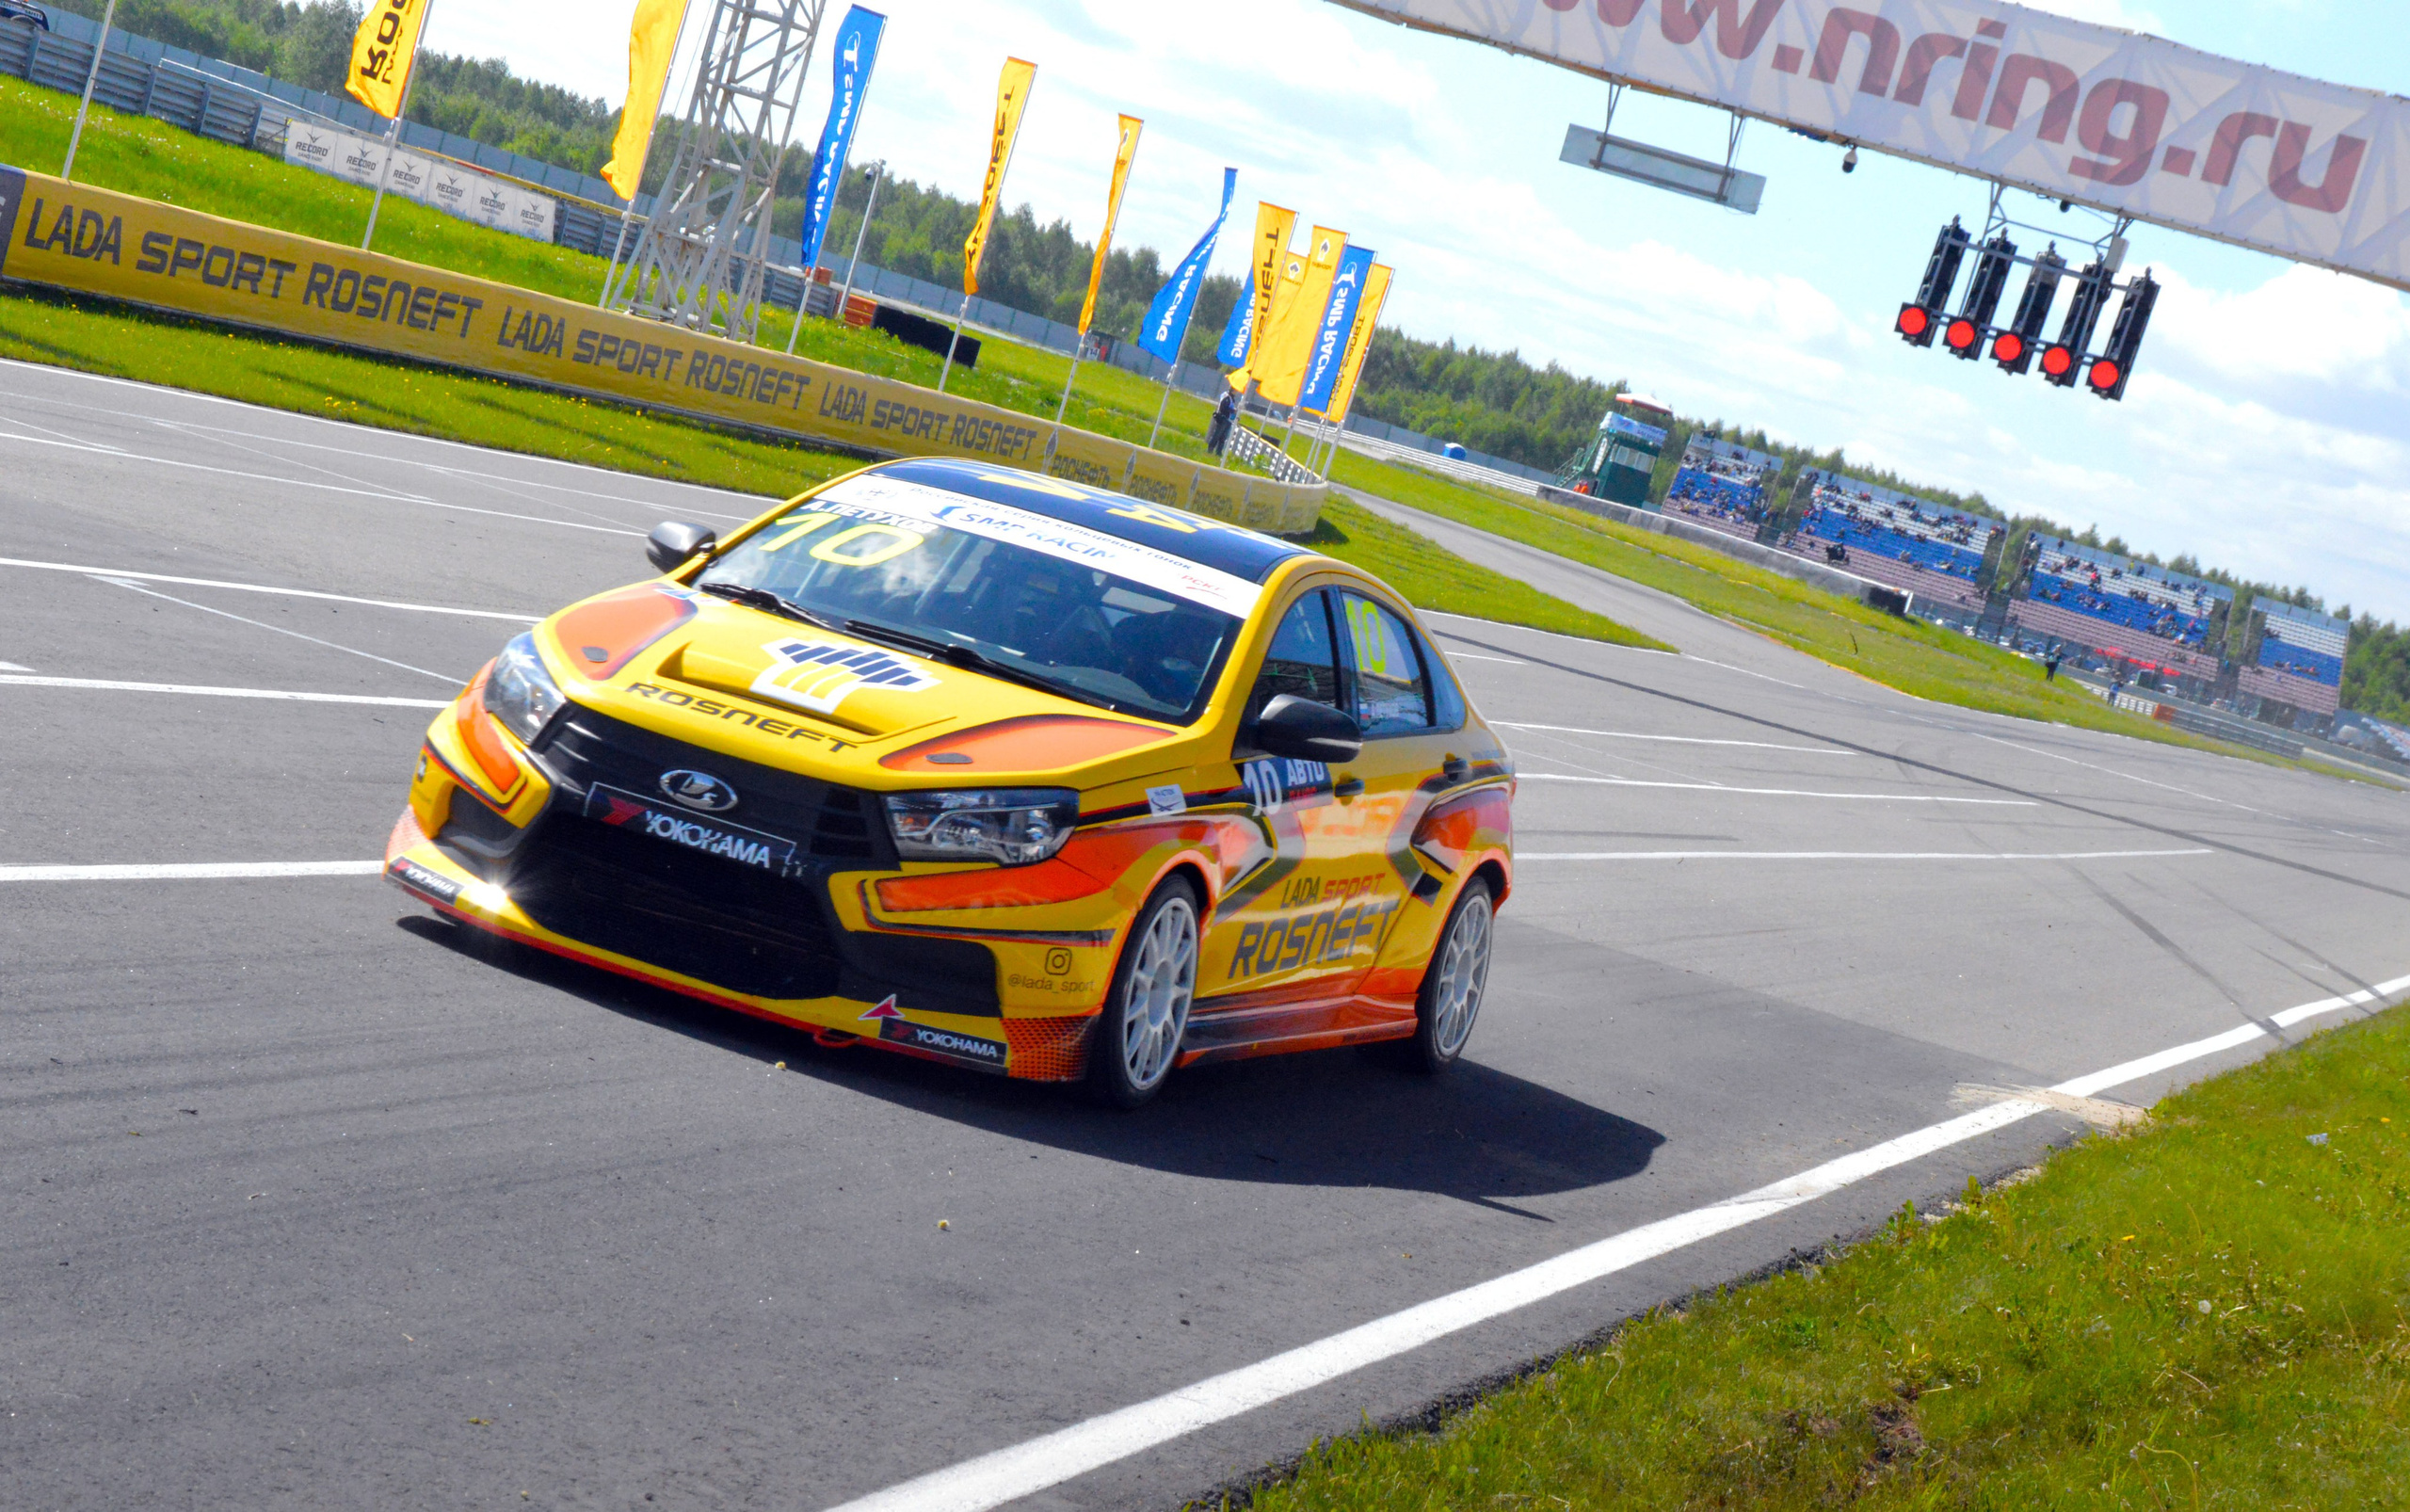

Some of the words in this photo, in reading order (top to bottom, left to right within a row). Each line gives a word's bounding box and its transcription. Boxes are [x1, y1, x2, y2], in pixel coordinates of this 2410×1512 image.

[1542, 0, 2368, 215] w.nring.ru
[295, 141, 329, 157] RECORD
[346, 155, 377, 171] RECORD
[394, 169, 421, 185] RECORD
[436, 182, 463, 198] RECORD
[479, 196, 506, 211] RECORD
[520, 209, 545, 223] RECORD
[24, 198, 121, 265] LADA
[136, 231, 297, 298] SPORT
[302, 262, 484, 338] ROSNEFT
[497, 305, 565, 358] LADA
[572, 330, 683, 381] SPORT
[684, 349, 811, 410] ROSNEFT
[819, 381, 867, 425] LADA
[870, 399, 949, 442] SPORT
[950, 413, 1037, 460] ROSNEFT
[758, 512, 924, 567] 10
[1026, 530, 1117, 559] RACIN
[1346, 601, 1386, 673] 10
[625, 683, 858, 752] ROSNEFT
[1244, 759, 1282, 817] 10
[646, 811, 770, 868] YOKOHAMA
[1280, 877, 1321, 909] LADA
[1322, 873, 1386, 902] SPORT
[1228, 898, 1401, 979] ROSNEFT
[1008, 973, 1096, 994] @lada_sport
[916, 1028, 998, 1058] YOKOHAMA
